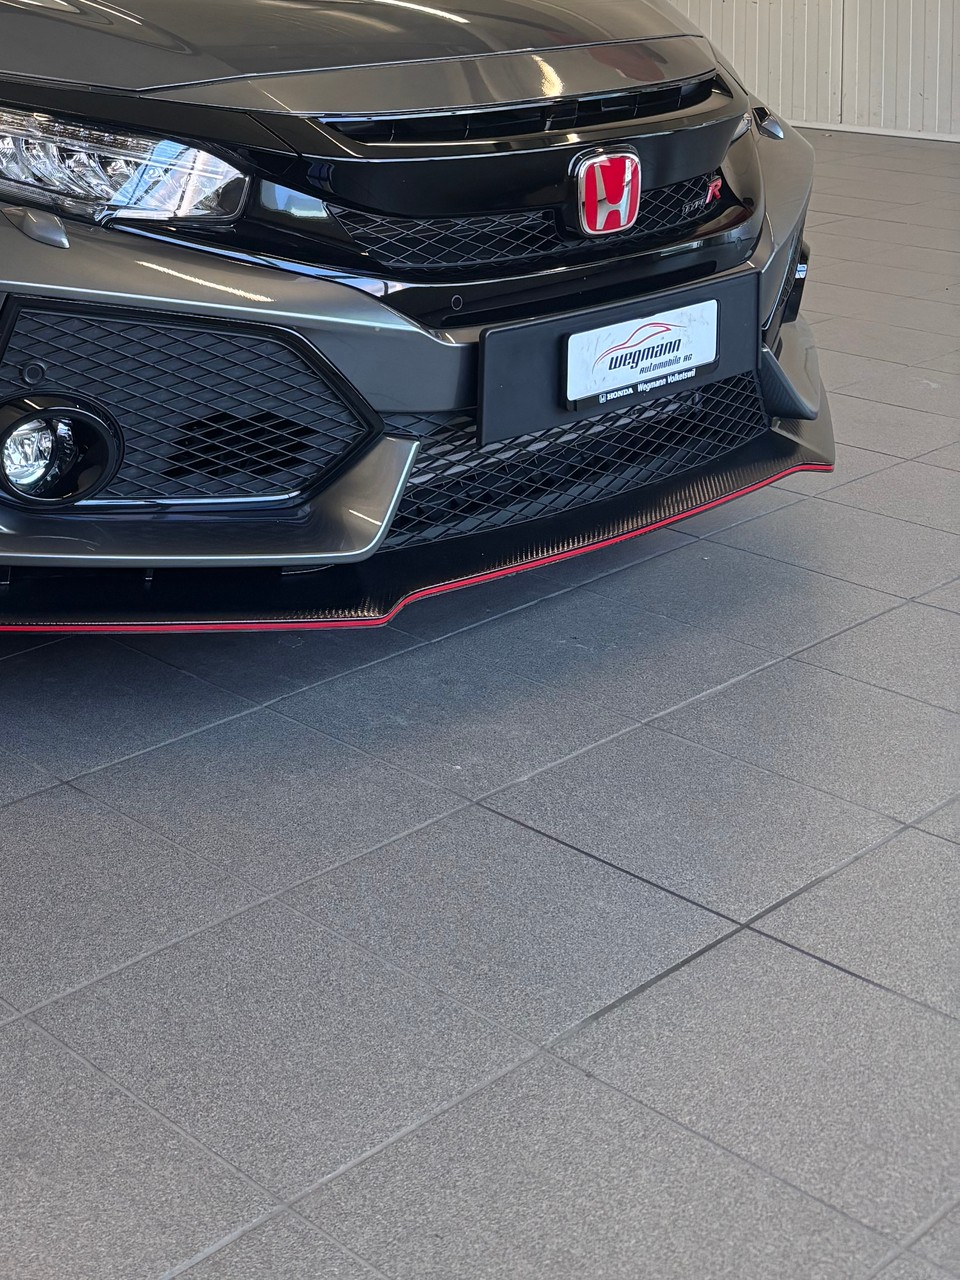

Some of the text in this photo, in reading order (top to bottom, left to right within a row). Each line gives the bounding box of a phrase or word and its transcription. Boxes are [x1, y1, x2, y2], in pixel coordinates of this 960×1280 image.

[705, 178, 722, 204] R
[608, 338, 682, 371] wegmann
[606, 387, 634, 400] HONDA
[637, 378, 667, 393] Wegmann
